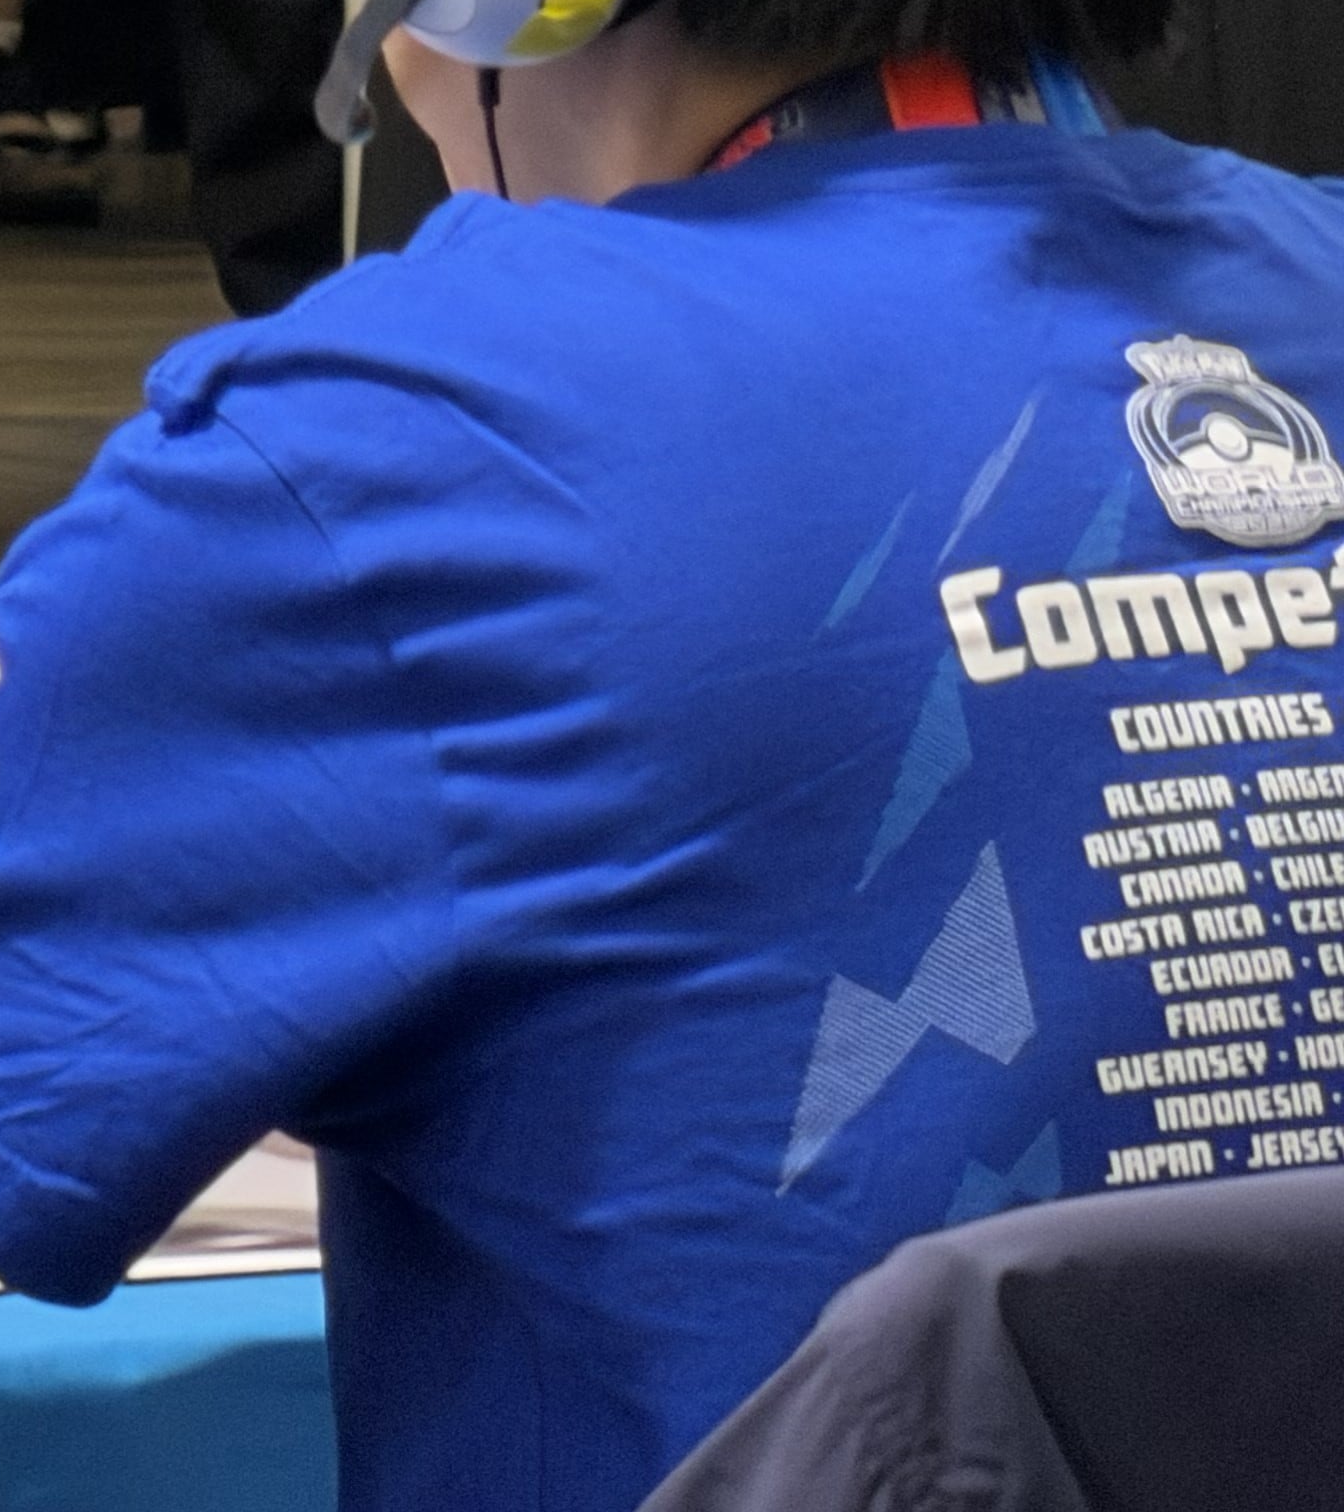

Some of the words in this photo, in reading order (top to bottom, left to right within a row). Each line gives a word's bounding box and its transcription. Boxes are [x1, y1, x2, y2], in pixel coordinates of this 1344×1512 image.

[939, 541, 1344, 684] Compe
[1110, 692, 1335, 754] COUNTRIES
[1102, 774, 1236, 820] ALGERIA
[1082, 818, 1223, 870] AUSTRIA
[1119, 860, 1247, 909] CANADA
[1079, 913, 1188, 961] COSTA
[1191, 903, 1267, 944] RICA
[1149, 946, 1295, 996] ECUADOR
[1164, 992, 1286, 1040] FRANCE
[1095, 1040, 1269, 1095] GUERNSEY
[1153, 1081, 1325, 1132] INDONESIA
[1104, 1139, 1215, 1186] JAPAN
